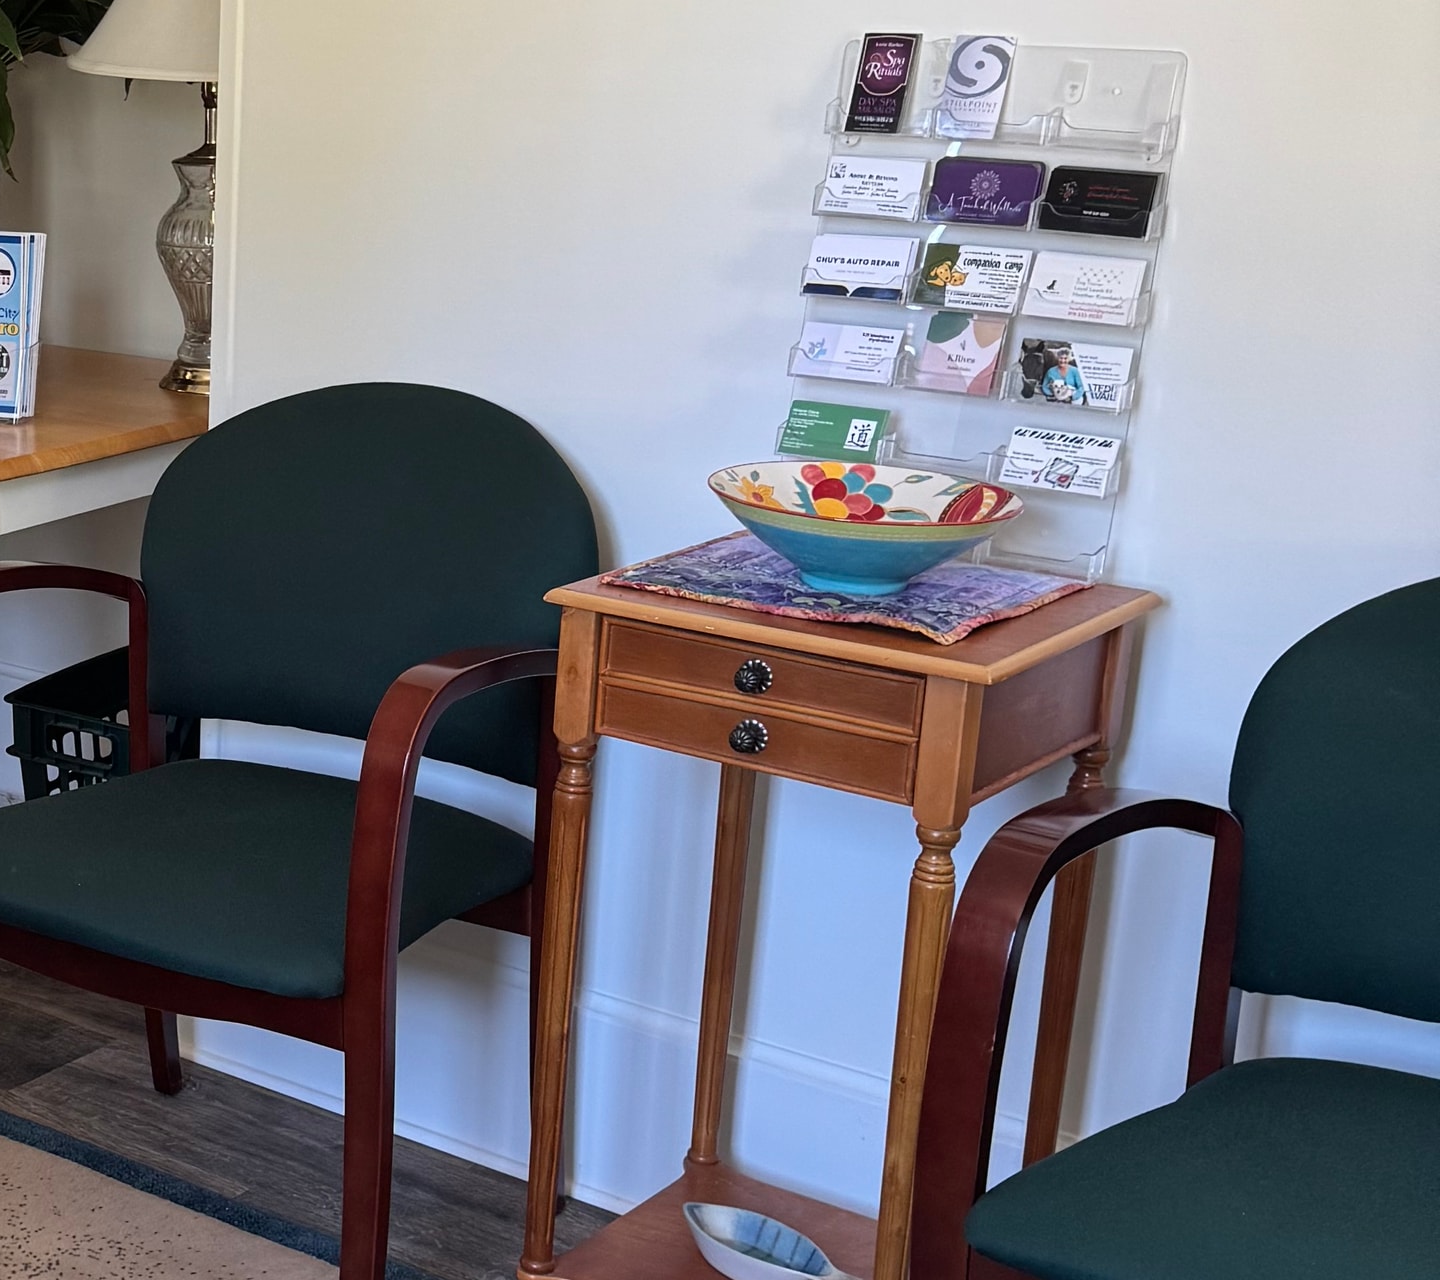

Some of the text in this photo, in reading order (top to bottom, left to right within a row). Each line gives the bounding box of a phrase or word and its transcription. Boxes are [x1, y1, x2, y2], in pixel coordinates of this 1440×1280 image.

[883, 49, 906, 69] Spa
[865, 62, 903, 80] Rituals
[815, 256, 901, 268] CHUY'S AUTO REPAIR
[1004, 261, 1024, 273] camp
